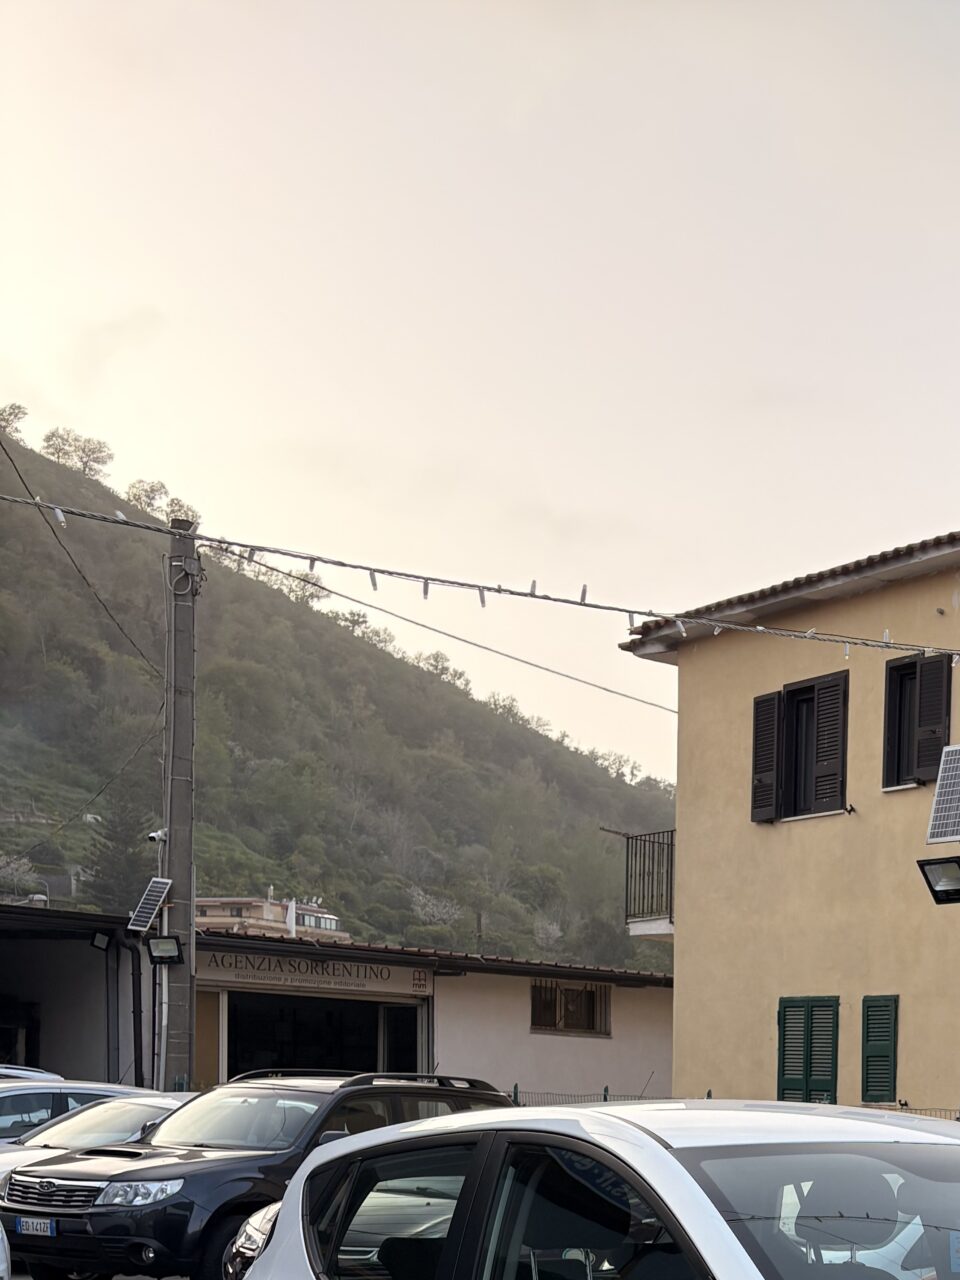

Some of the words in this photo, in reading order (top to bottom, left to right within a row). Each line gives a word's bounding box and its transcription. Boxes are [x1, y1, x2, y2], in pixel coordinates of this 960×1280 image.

[208, 953, 284, 973] AGENZIA
[288, 959, 391, 982] SORRENTINO
[234, 971, 282, 982] distribuzione
[290, 977, 332, 987] promozione
[333, 979, 366, 989] editoriale
